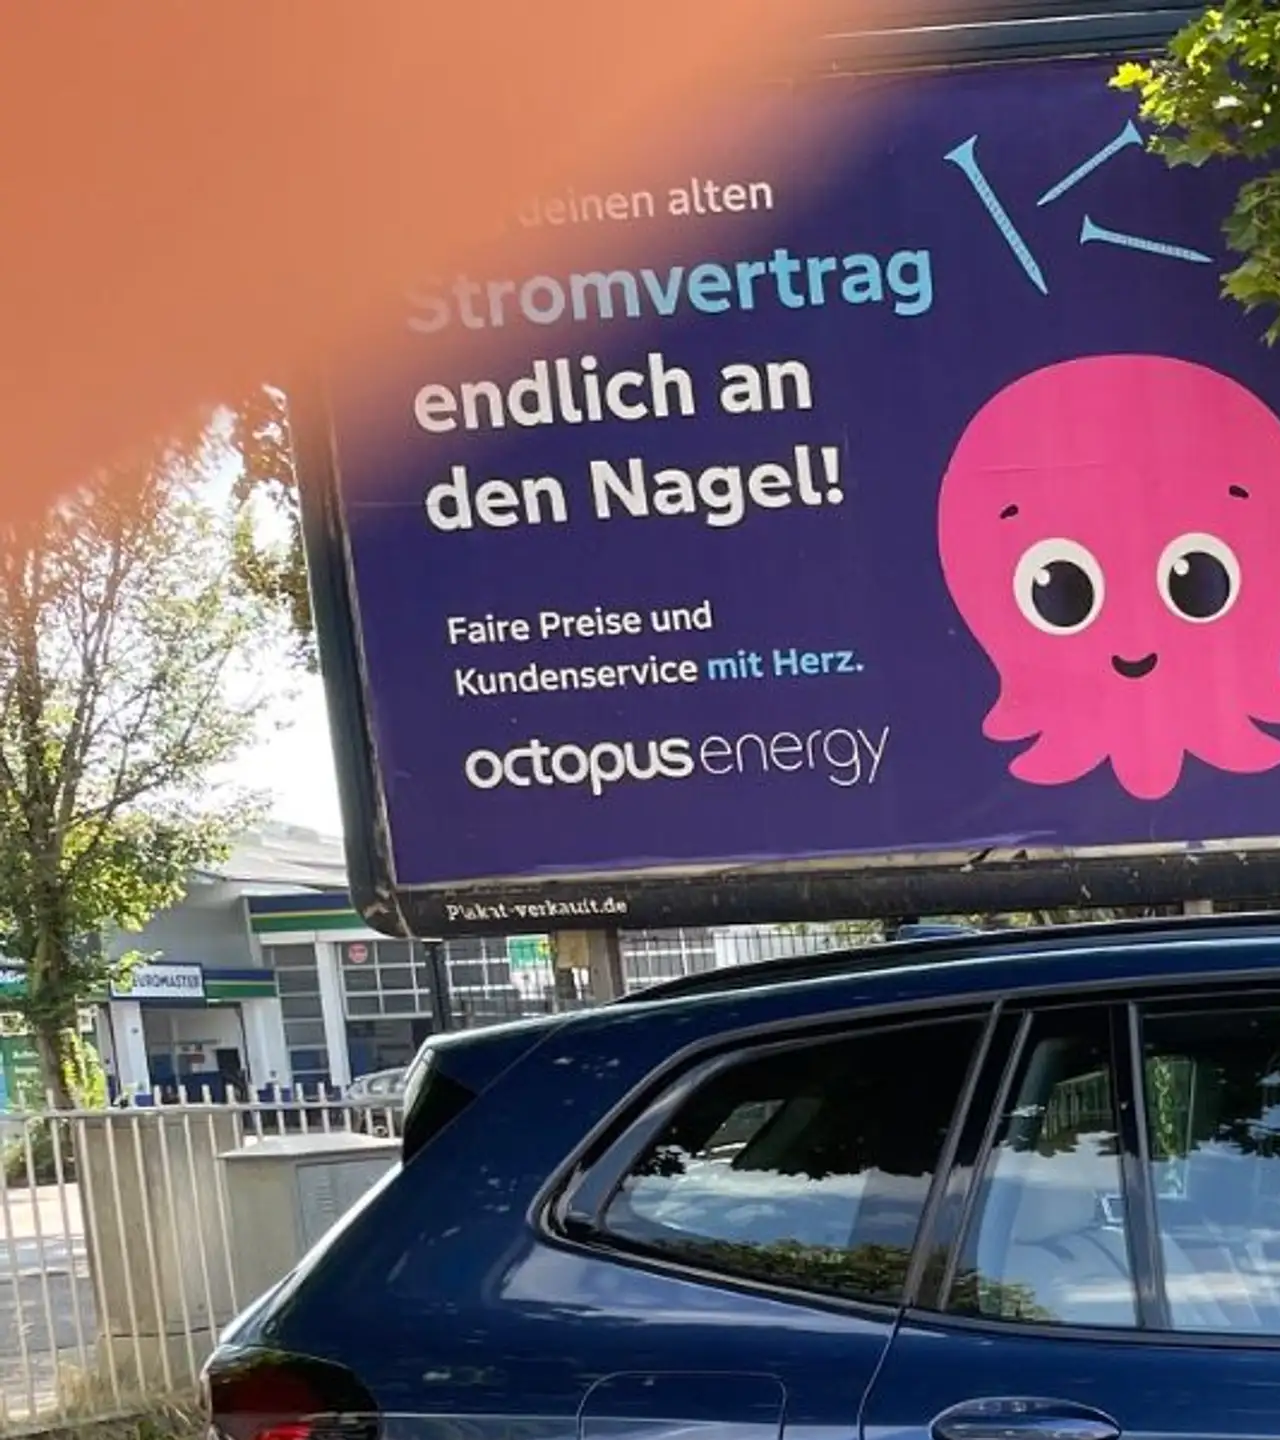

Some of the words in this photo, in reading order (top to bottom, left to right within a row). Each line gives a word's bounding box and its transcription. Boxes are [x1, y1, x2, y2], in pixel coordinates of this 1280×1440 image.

[518, 185, 654, 227] deinen
[668, 178, 773, 216] alten
[403, 249, 933, 333] Stromvertrag
[413, 352, 695, 433] endlich
[719, 359, 813, 413] an
[426, 466, 567, 531] den
[590, 446, 844, 527] Nagel!
[447, 614, 530, 645] Faire
[539, 607, 642, 639] Preise
[651, 600, 713, 631] und
[455, 656, 698, 696] Kundenservice
[708, 650, 763, 680] mit
[773, 648, 865, 677] Herz.
